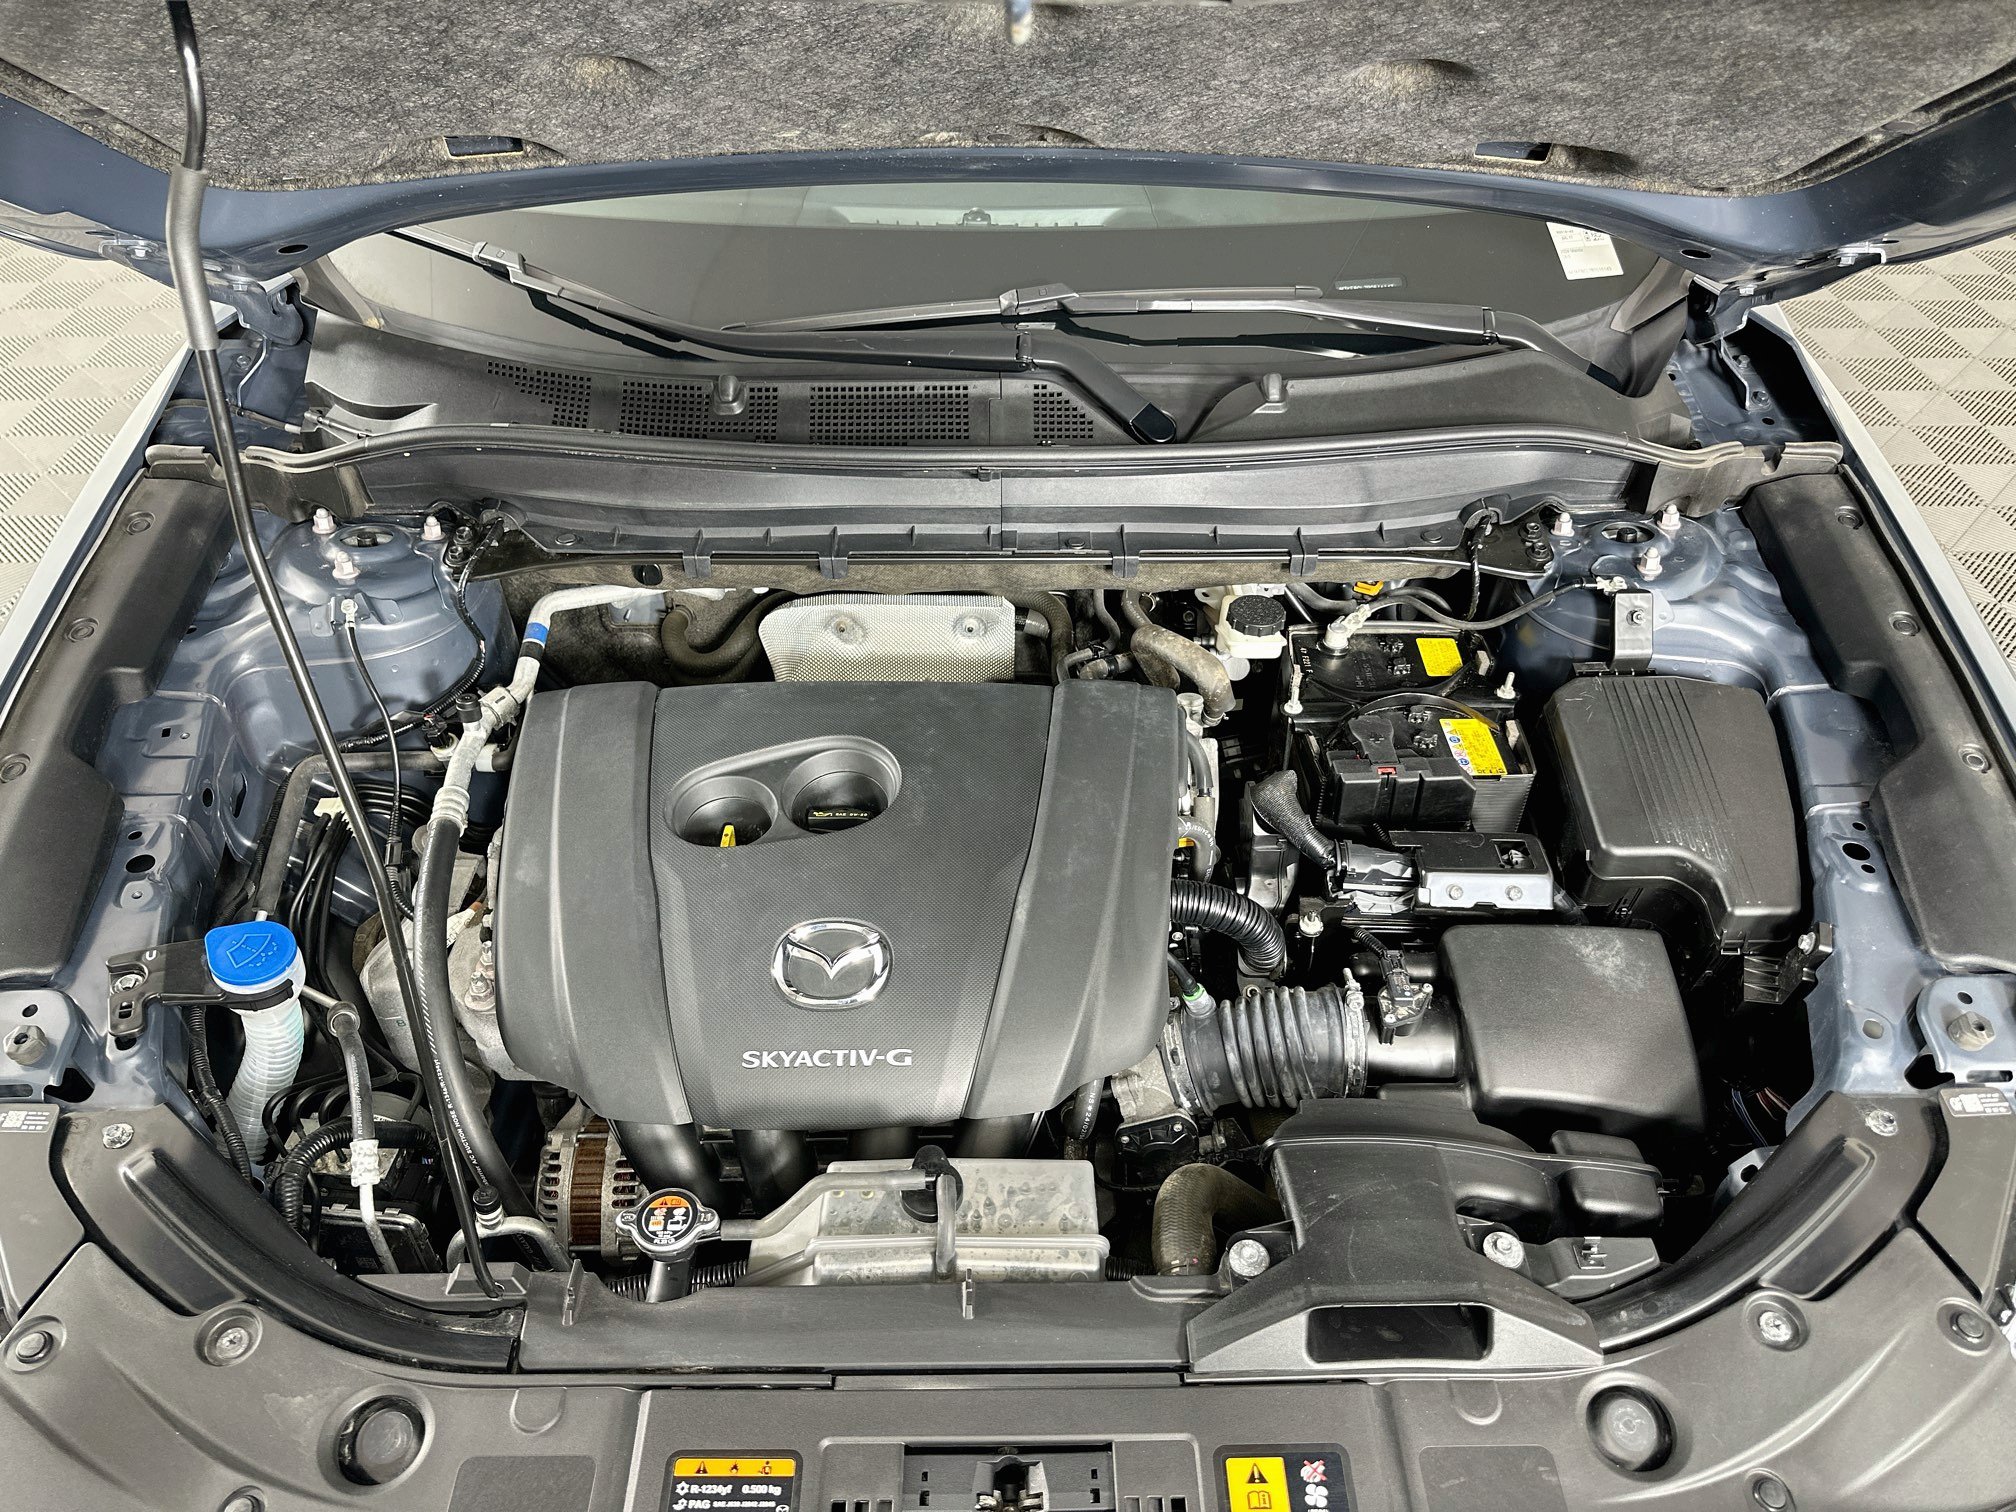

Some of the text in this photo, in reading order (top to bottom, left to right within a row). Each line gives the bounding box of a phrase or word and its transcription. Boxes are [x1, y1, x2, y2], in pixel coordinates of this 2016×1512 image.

[741, 1048, 913, 1069] SKYACTIV-G
[689, 1484, 783, 1496] R-1234yf 0.500 kg
[687, 1499, 711, 1509] PAG
